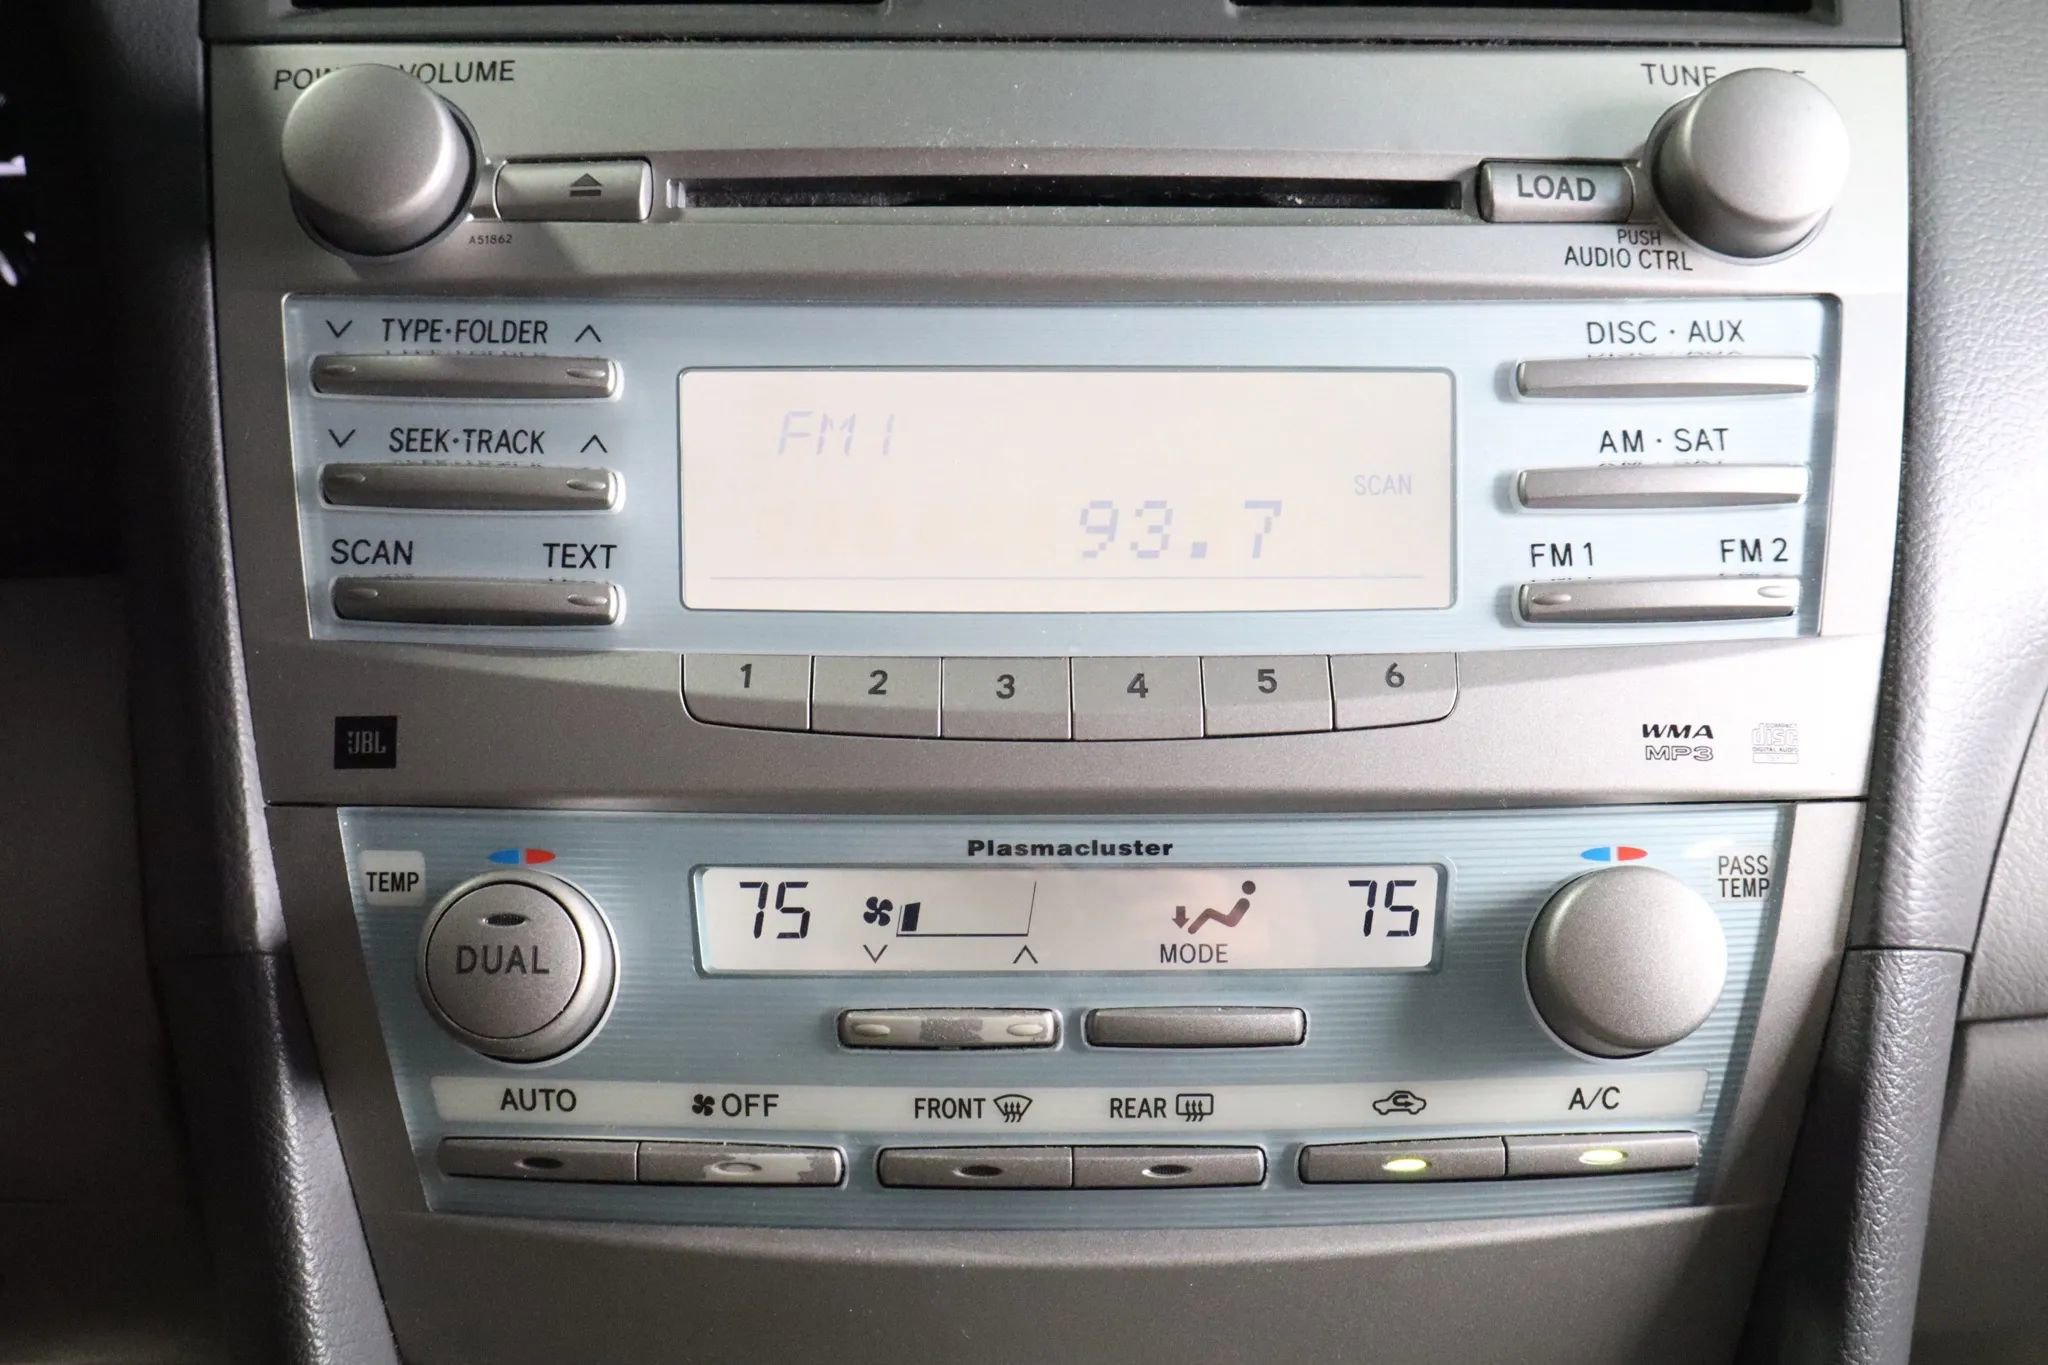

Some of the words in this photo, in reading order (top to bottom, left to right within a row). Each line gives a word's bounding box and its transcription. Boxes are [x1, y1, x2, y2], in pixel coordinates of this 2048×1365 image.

[274, 68, 341, 90] PO
[1641, 63, 1716, 87] TUNE
[1517, 173, 1596, 201] LOAD
[468, 234, 513, 246] A51862
[1617, 228, 1661, 246] PUSH
[1564, 246, 1632, 269] AUDIO
[1638, 248, 1694, 271] CTRL
[1354, 474, 1412, 496] SCAN
[1079, 499, 1283, 560] 93.7
[330, 539, 414, 565] SCAN
[543, 543, 617, 569] TEXT
[740, 663, 753, 689] 1
[867, 669, 889, 695] 2
[995, 674, 1016, 699] 3
[1126, 673, 1149, 698] 4
[1257, 669, 1278, 694] 5
[1384, 663, 1405, 688] 6
[347, 731, 387, 754] JBL
[1642, 724, 1714, 739] WMA
[1645, 745, 1714, 761] MP3
[967, 839, 1174, 857] Plasmacluster
[1718, 855, 1769, 876] PASS
[366, 871, 420, 893] TEMP
[1718, 878, 1770, 898] TEMP
[740, 881, 811, 939] 75
[1348, 880, 1420, 938] 75
[456, 944, 550, 975] DUAL
[1160, 943, 1229, 964] MODE
[500, 1088, 577, 1112] AUTO
[721, 1093, 780, 1117] OFF
[914, 1097, 986, 1120] FRONT
[1109, 1097, 1168, 1119] REAR
[1568, 1086, 1621, 1111] A/C
